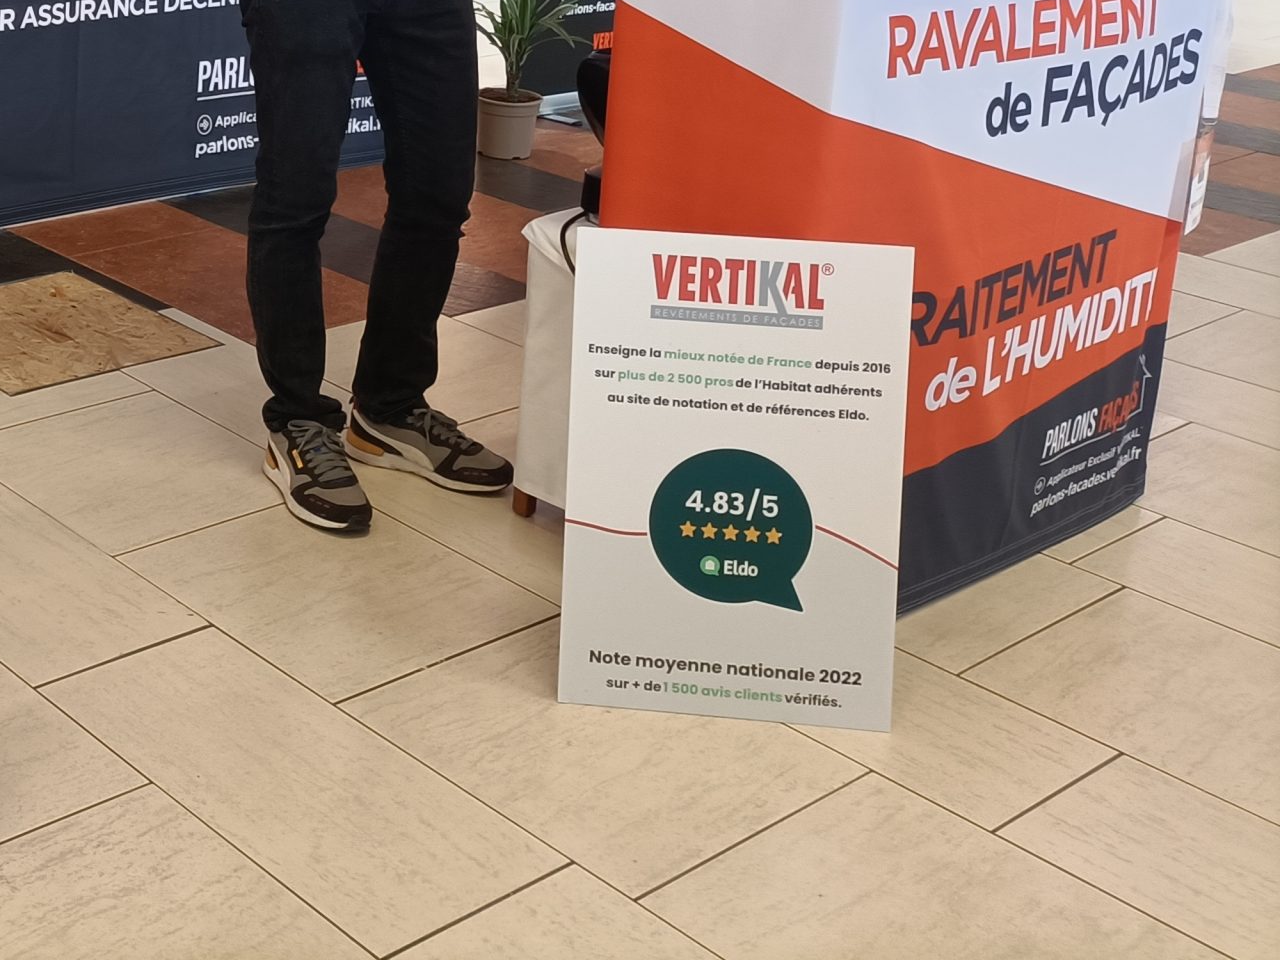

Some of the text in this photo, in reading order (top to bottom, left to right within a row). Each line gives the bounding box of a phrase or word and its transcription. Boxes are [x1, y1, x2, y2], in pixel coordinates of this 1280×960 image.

[986, 28, 1203, 137] de FAÇADES
[654, 307, 820, 329] REVÊTEMENTS DE FAÇADES
[588, 343, 892, 374] Enseigne la mieux notée de France depuis 2016
[594, 369, 616, 379] sur
[618, 370, 646, 382] plus
[648, 371, 665, 382] de
[667, 373, 675, 383] 2
[677, 373, 702, 385] 500
[704, 377, 734, 389] pros
[735, 378, 752, 388] de
[814, 384, 883, 397] adhérents
[925, 357, 976, 411] de
[607, 393, 869, 421] au site de notation et de références Eldo.
[1042, 408, 1098, 459] PARLONS
[1047, 447, 1116, 487] Applicateur Exclusif
[685, 488, 779, 522] 4.83/5
[723, 560, 759, 577] Eldo
[589, 649, 863, 686] Note moyenne nationale 2022
[606, 677, 842, 709] sur de 500 avis clients vérifiés.
